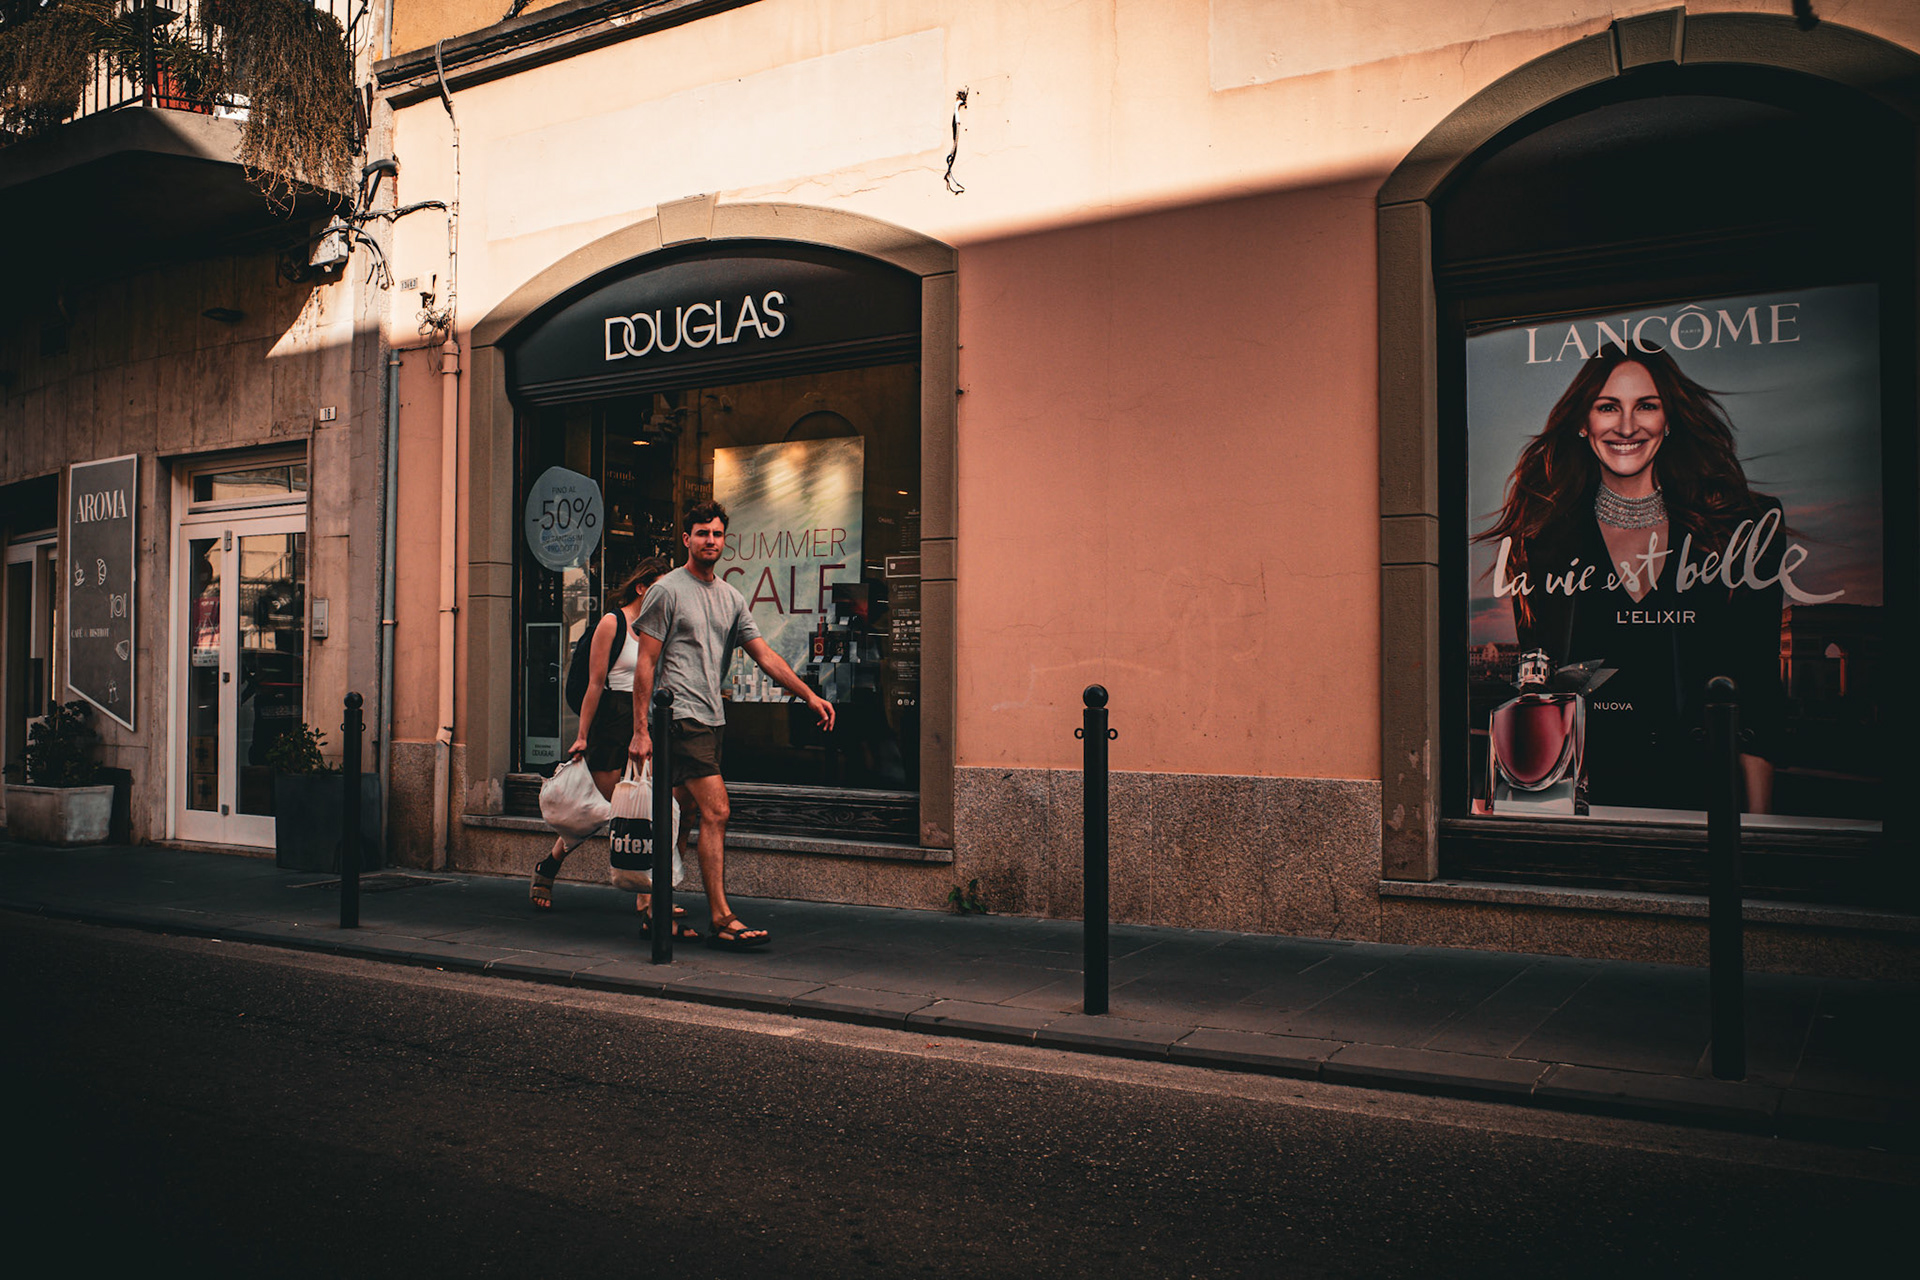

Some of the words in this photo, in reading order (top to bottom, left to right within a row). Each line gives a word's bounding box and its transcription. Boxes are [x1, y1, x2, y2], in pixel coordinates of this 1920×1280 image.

[605, 290, 786, 361] DOUGLAS
[1525, 302, 1801, 364] LANCÔME
[75, 489, 128, 524] AROMA
[532, 497, 596, 530] -50%
[723, 528, 847, 562] SUMMER
[1545, 557, 1597, 596] vie
[1601, 531, 1674, 593] est
[1676, 508, 1846, 604] belle
[1616, 610, 1696, 624] L'ELIXIR
[1593, 701, 1634, 711] NUOVA
